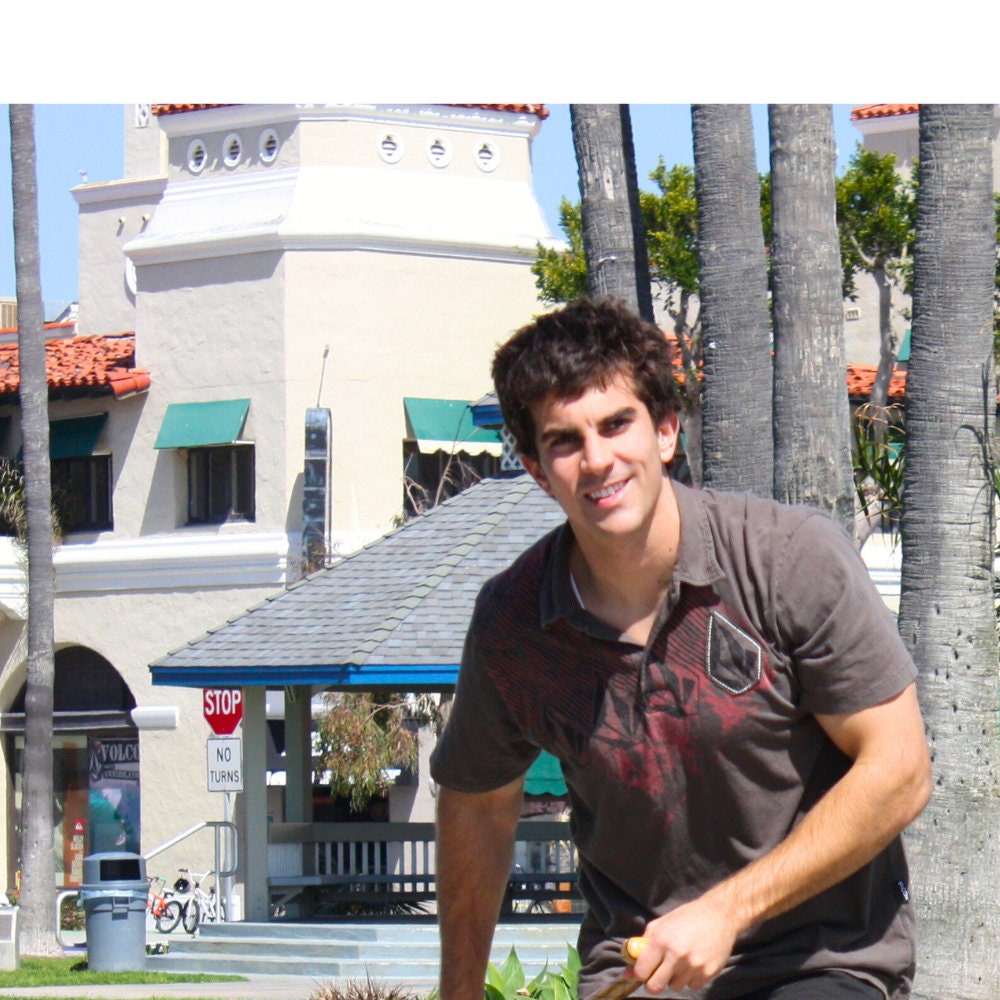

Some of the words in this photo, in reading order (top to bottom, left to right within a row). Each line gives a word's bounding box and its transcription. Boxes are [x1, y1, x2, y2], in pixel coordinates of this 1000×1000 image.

[205, 689, 242, 715] STOP
[216, 747, 232, 762] NO
[210, 770, 240, 783] TURNS
